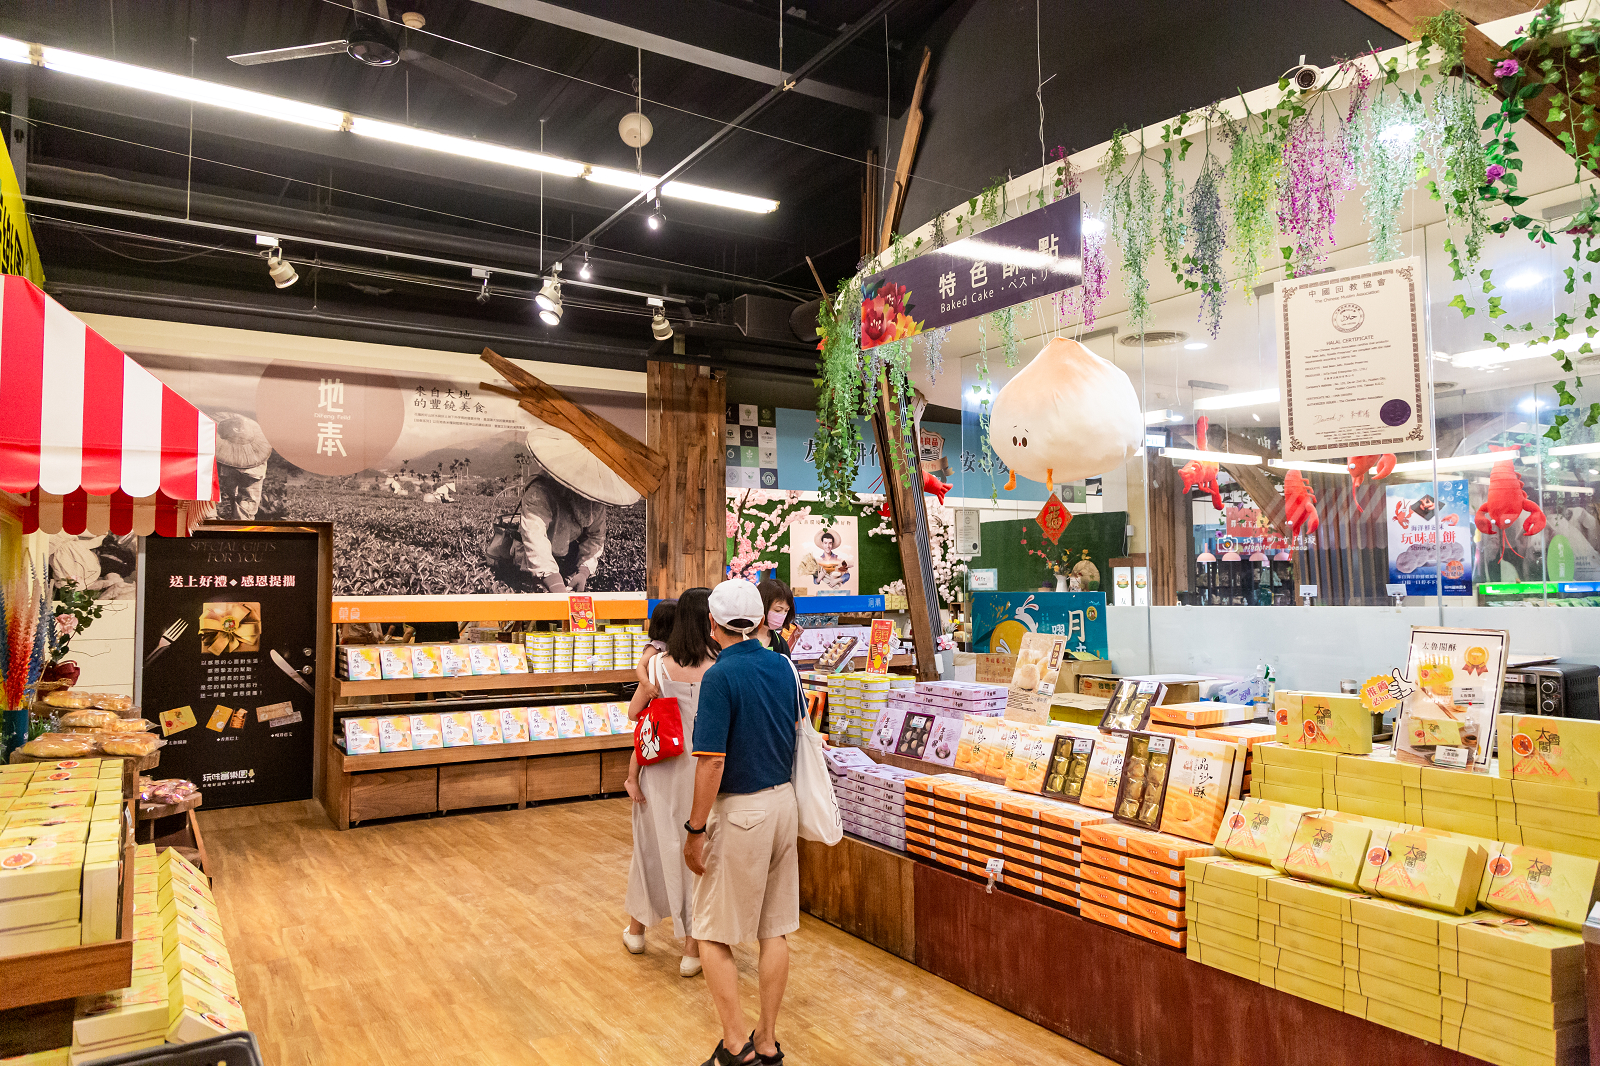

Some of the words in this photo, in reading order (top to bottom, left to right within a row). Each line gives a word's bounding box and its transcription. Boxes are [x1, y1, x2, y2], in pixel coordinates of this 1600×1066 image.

[940, 295, 968, 314] Baked
[971, 289, 995, 303] Cake
[415, 385, 472, 400] 來自大地
[190, 541, 236, 551] SPECIAL
[242, 541, 277, 551] GIFTS
[207, 553, 232, 563] FOR
[238, 552, 264, 563] YOU
[169, 575, 228, 588] 送上好禮
[1366, 680, 1389, 698] 推薦
